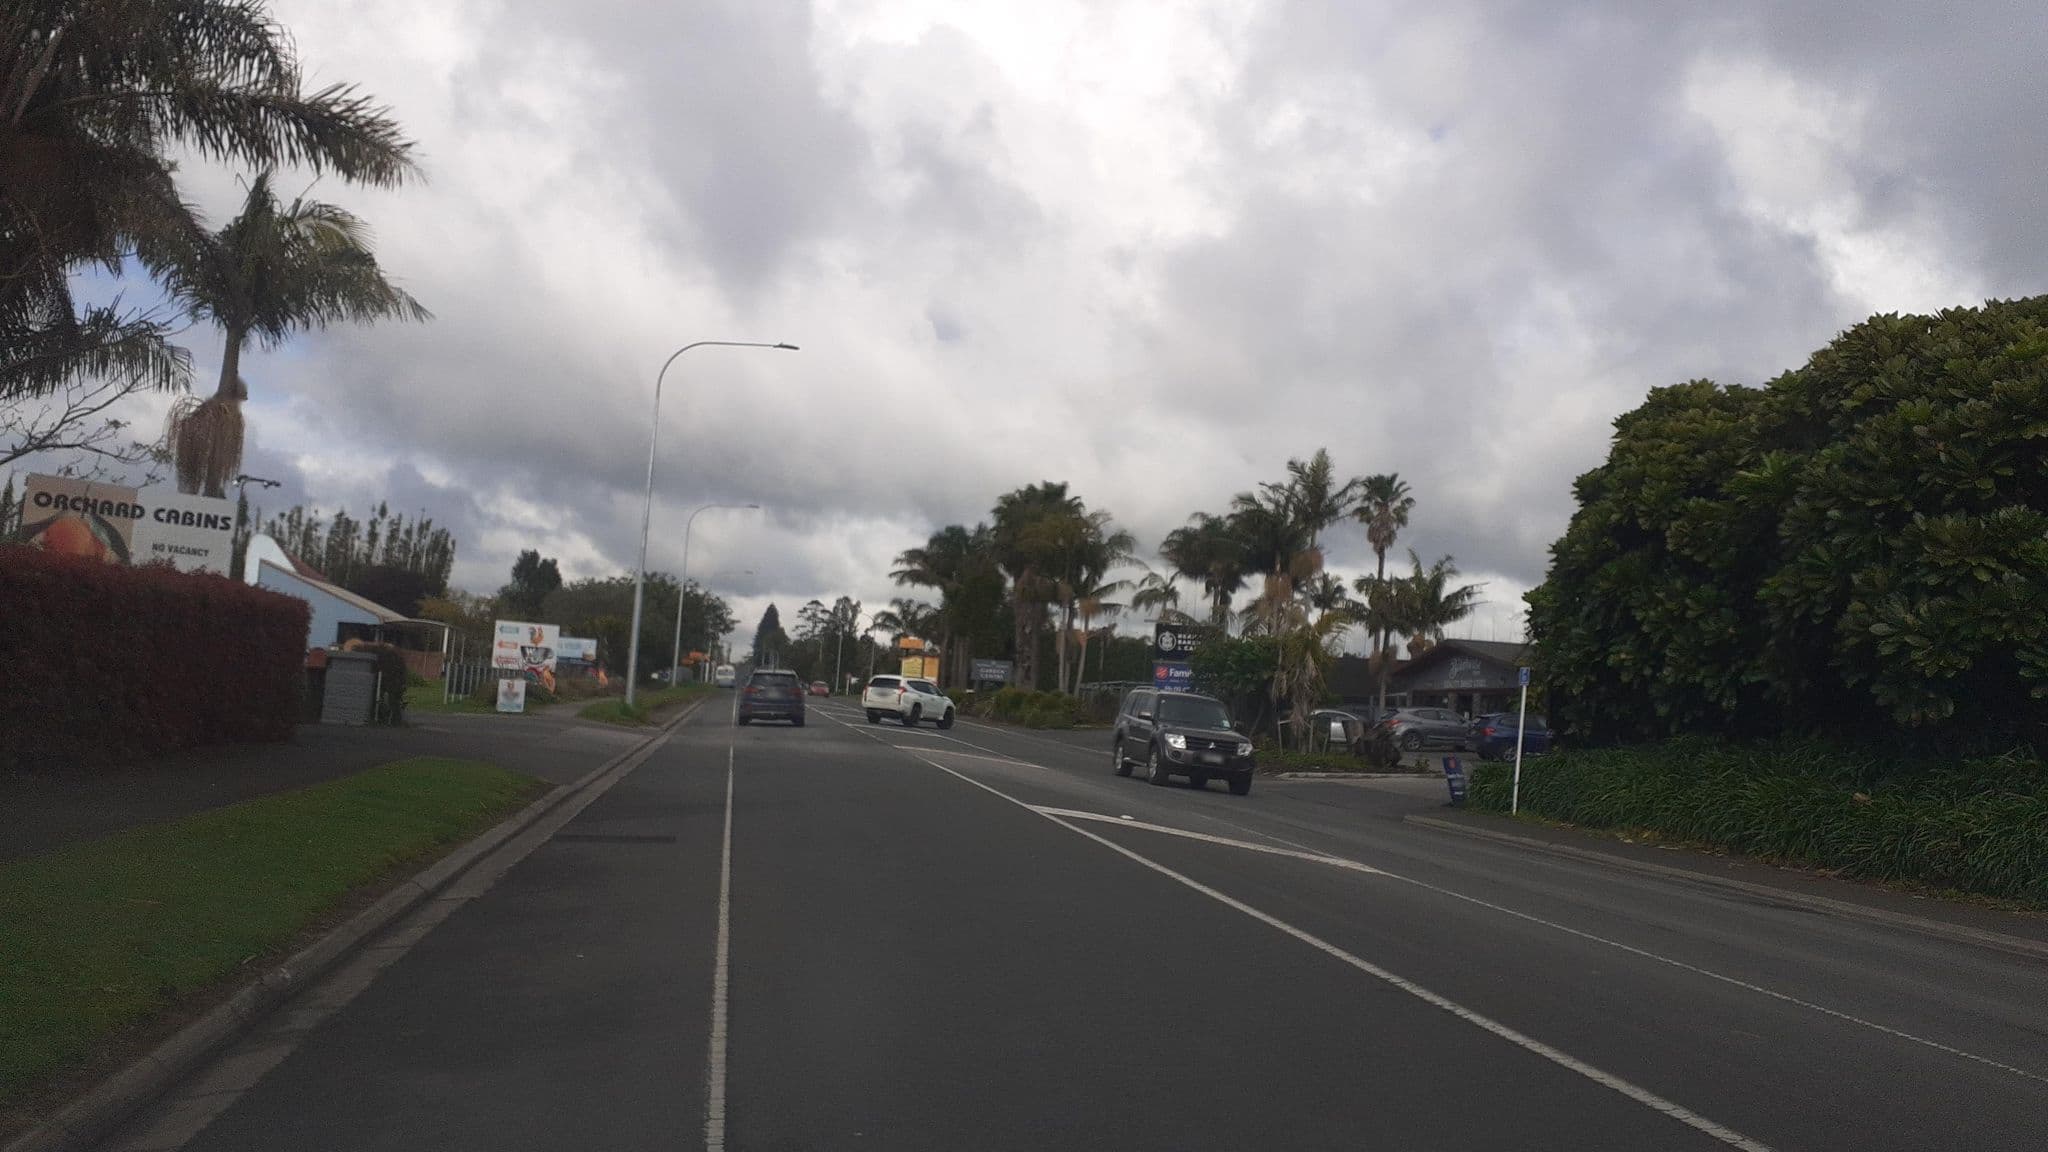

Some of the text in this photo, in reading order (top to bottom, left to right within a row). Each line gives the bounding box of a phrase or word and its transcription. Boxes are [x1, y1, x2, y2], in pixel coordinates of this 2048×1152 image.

[33, 490, 233, 531] ORCHARD CABINS
[152, 543, 209, 557] NO VACANCY
